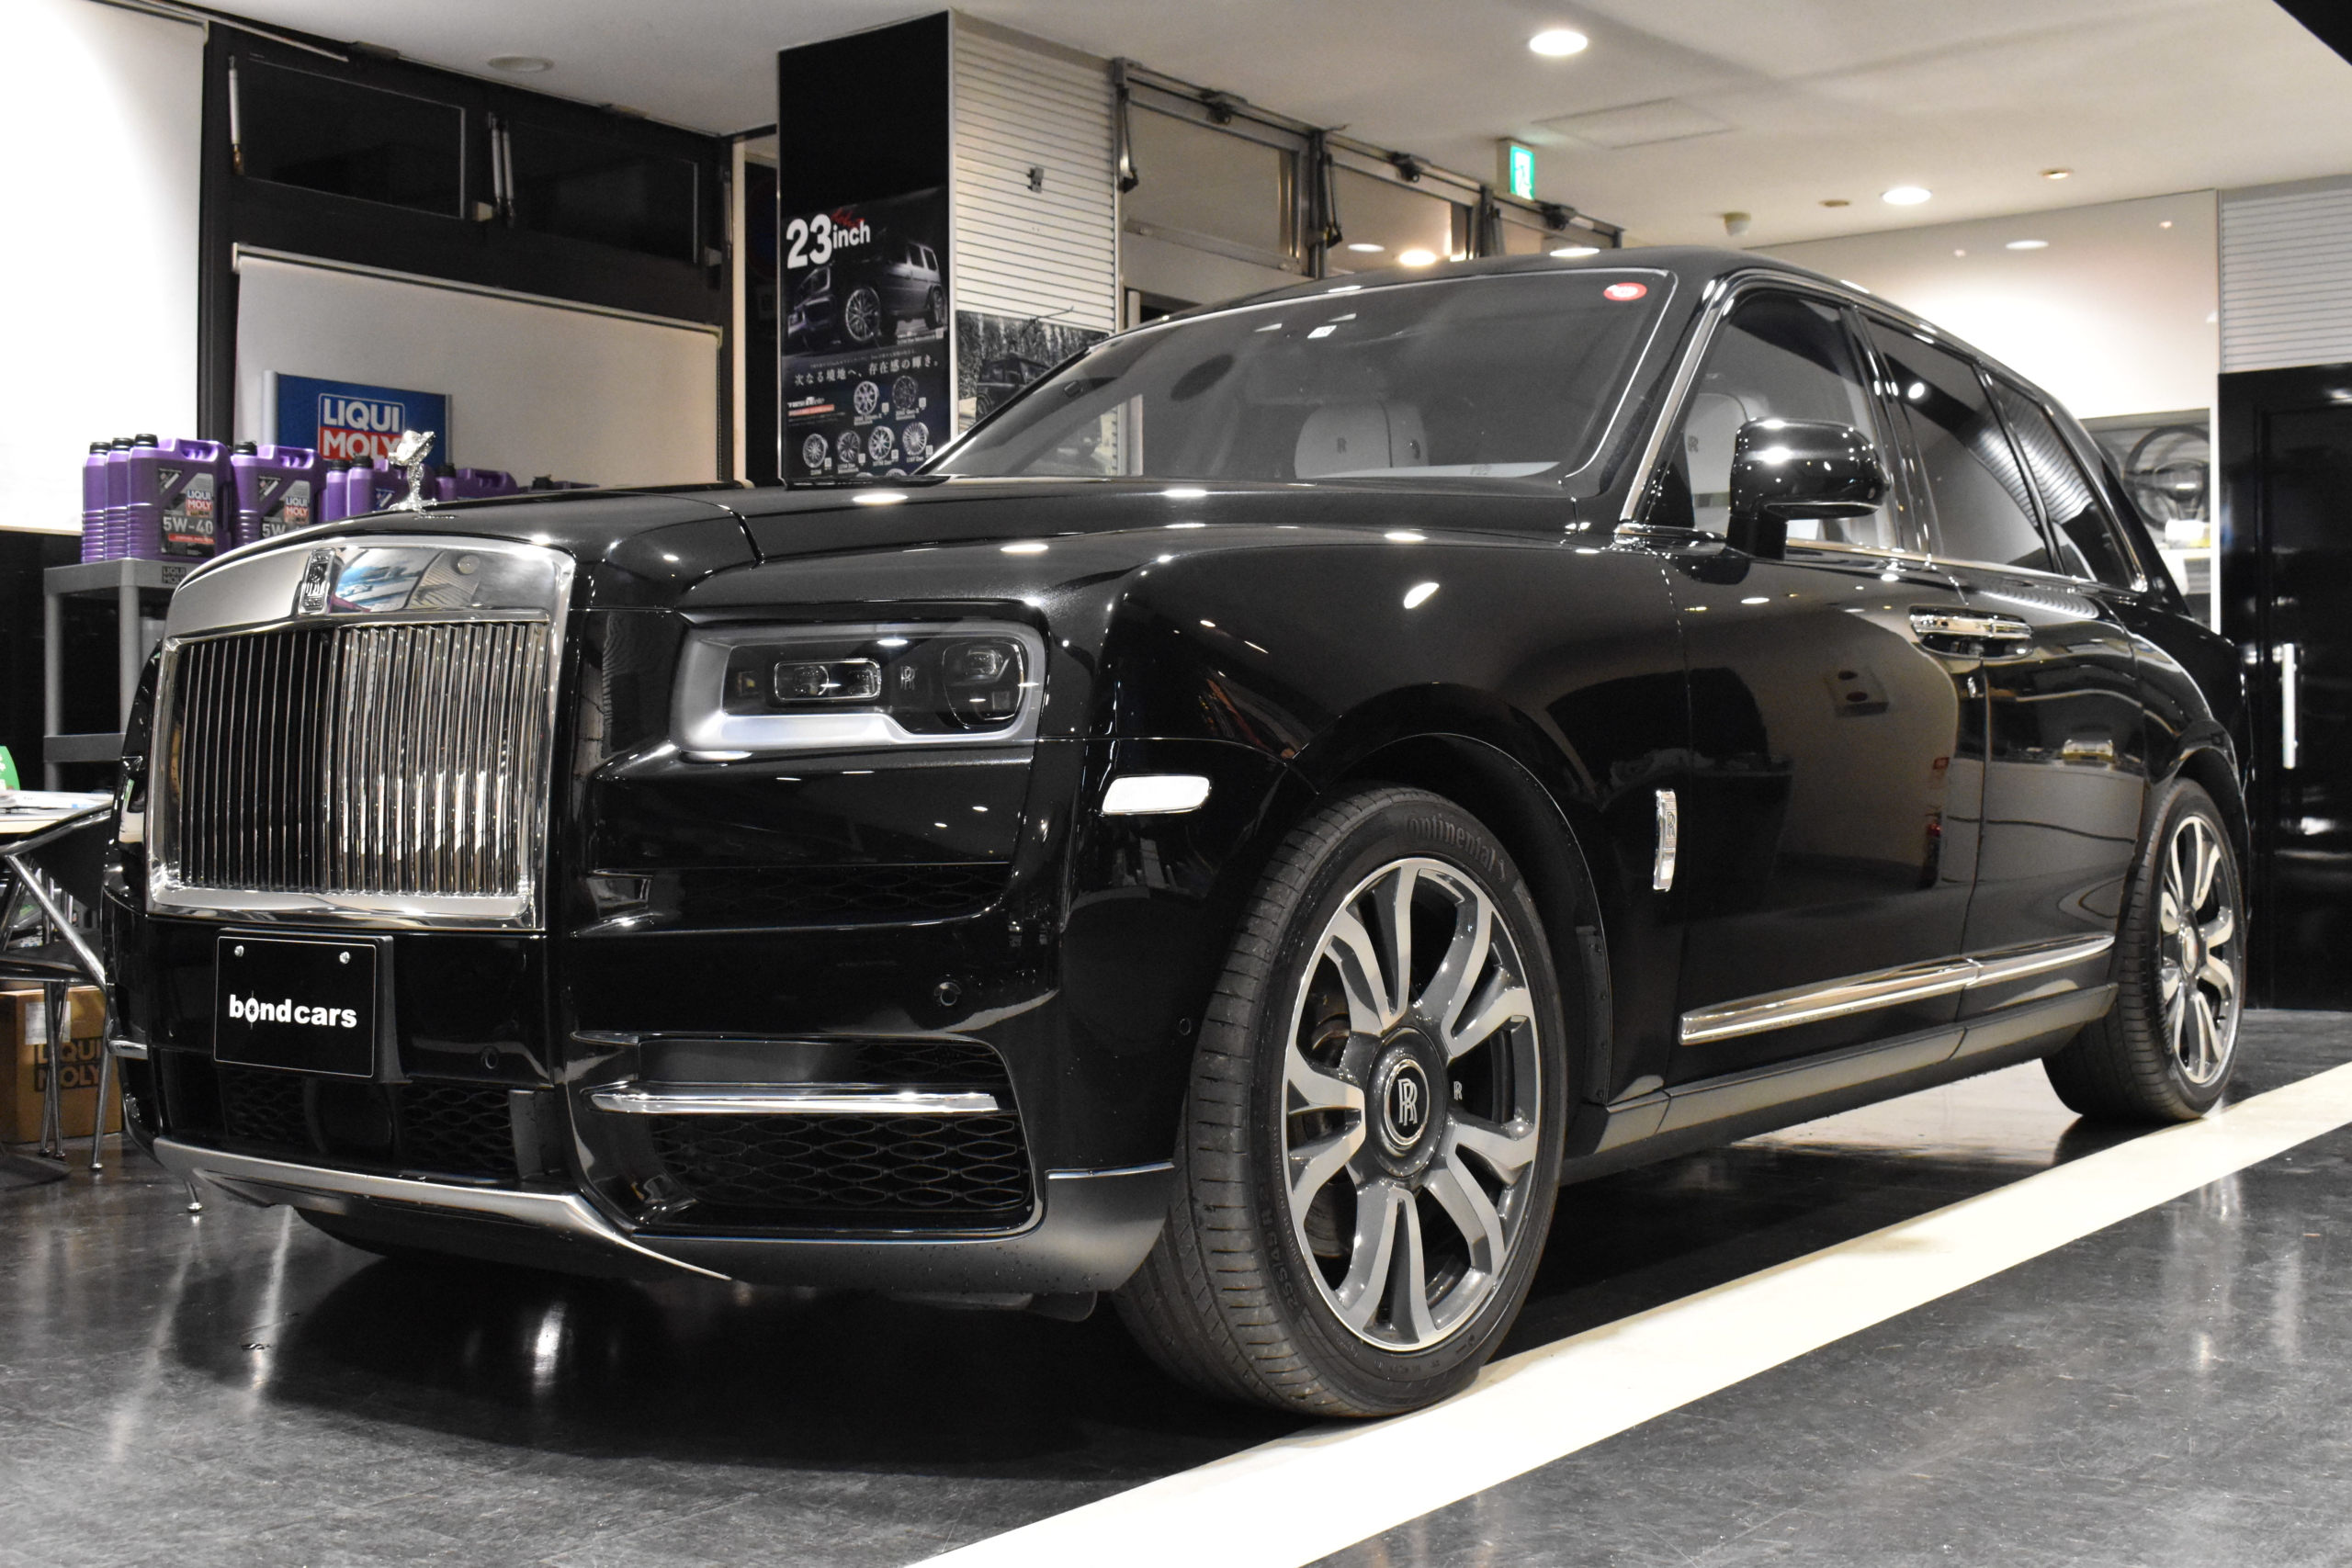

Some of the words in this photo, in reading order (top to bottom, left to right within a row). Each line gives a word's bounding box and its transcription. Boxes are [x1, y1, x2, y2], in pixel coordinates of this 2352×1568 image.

[323, 398, 400, 433] LIQUI
[323, 429, 401, 460] MOLY
[187, 490, 211, 501] LIQUI
[286, 497, 309, 507] LIQUI
[187, 500, 212, 511] MOLY
[286, 506, 309, 516] MOLY
[163, 516, 214, 535] 5W-40
[1407, 812, 1498, 874] ontinental
[38, 1039, 102, 1064] LQUI
